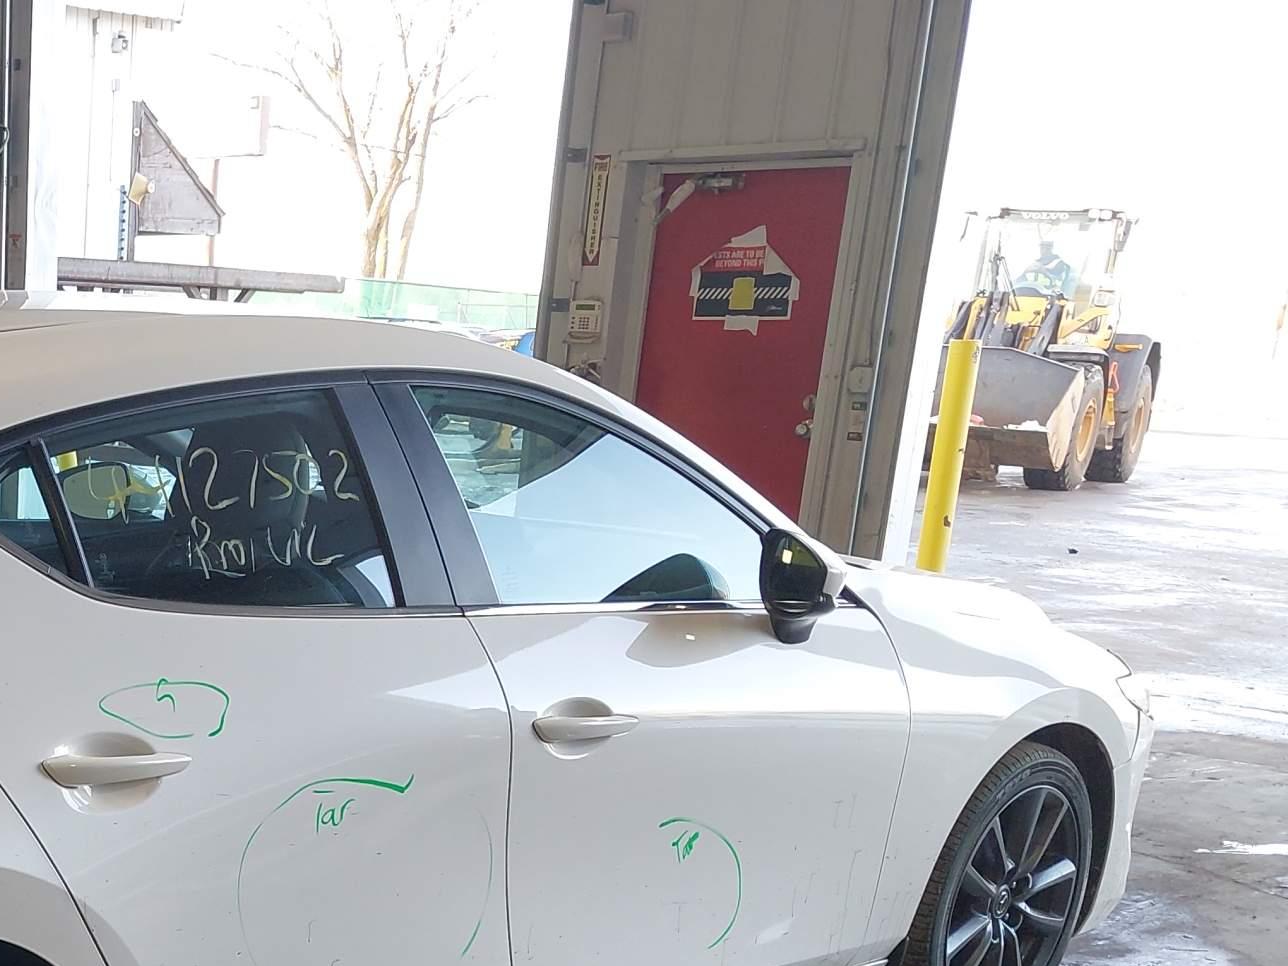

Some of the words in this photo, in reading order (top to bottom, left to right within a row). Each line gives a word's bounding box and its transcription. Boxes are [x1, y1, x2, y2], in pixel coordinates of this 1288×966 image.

[1021, 211, 1070, 220] VOLVO
[732, 250, 744, 258] ARE
[746, 249, 755, 258] TO
[715, 259, 742, 268] BEYOND
[88, 447, 360, 523] 44127502
